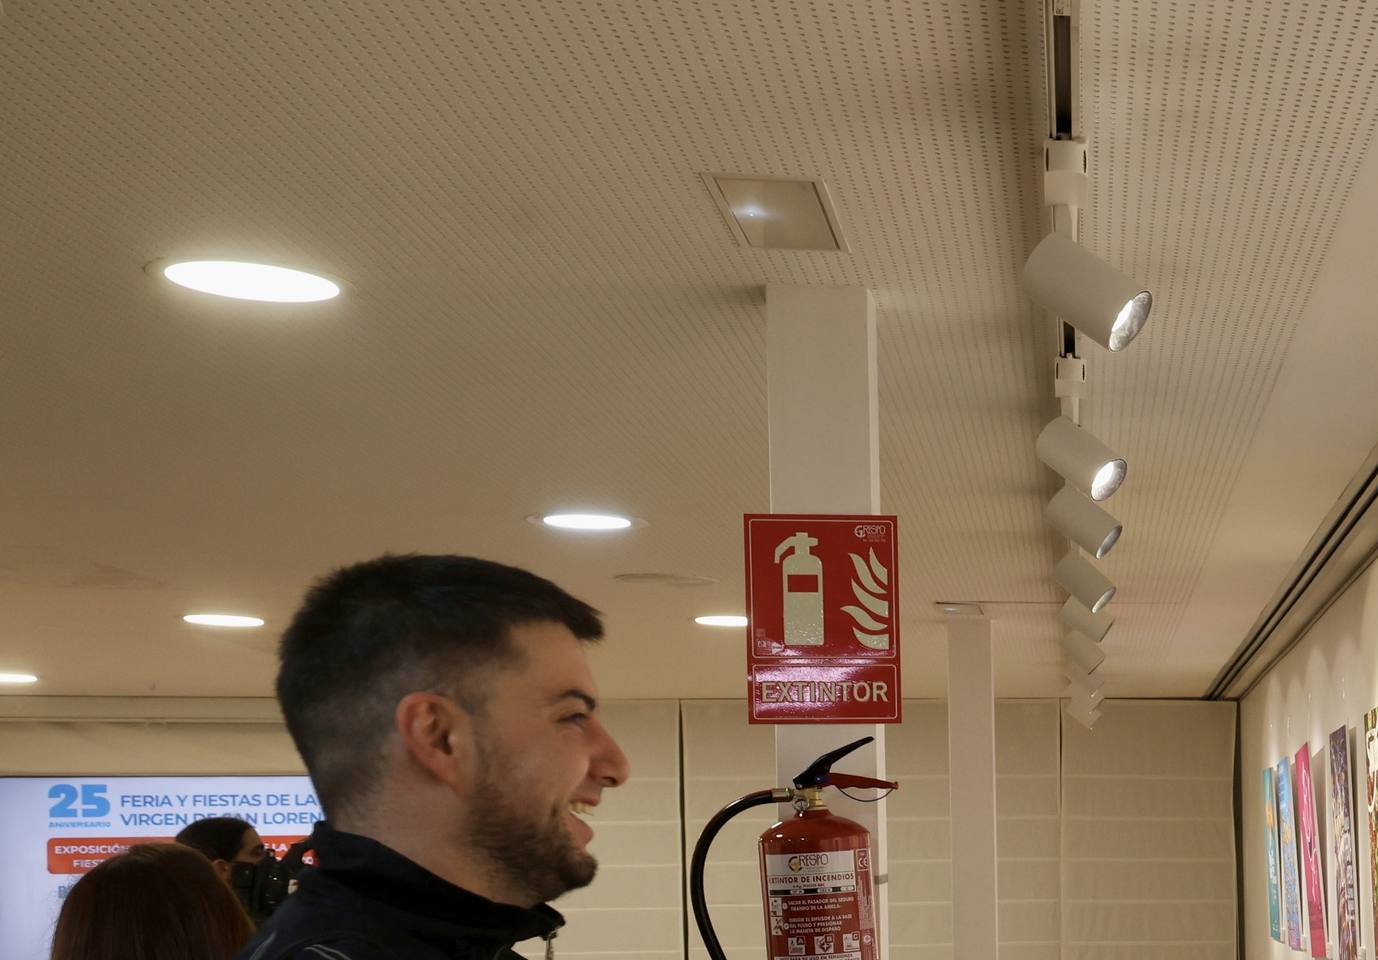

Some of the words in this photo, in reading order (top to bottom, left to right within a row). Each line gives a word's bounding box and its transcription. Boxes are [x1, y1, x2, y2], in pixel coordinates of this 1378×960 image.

[761, 681, 889, 703] EXTINTOR
[48, 783, 111, 818] 25
[120, 794, 174, 808] FERIA
[176, 794, 188, 808] Y
[192, 794, 262, 808] FIESTAS
[266, 794, 291, 807] DE
[295, 793, 319, 807] LA
[120, 812, 188, 826] VIRGEN
[264, 812, 324, 825] LOREN
[789, 853, 829, 874] CRESPO
[768, 875, 798, 885] EXTINTOR
[801, 875, 811, 883] DE
[812, 873, 855, 882] INCENDIOS
